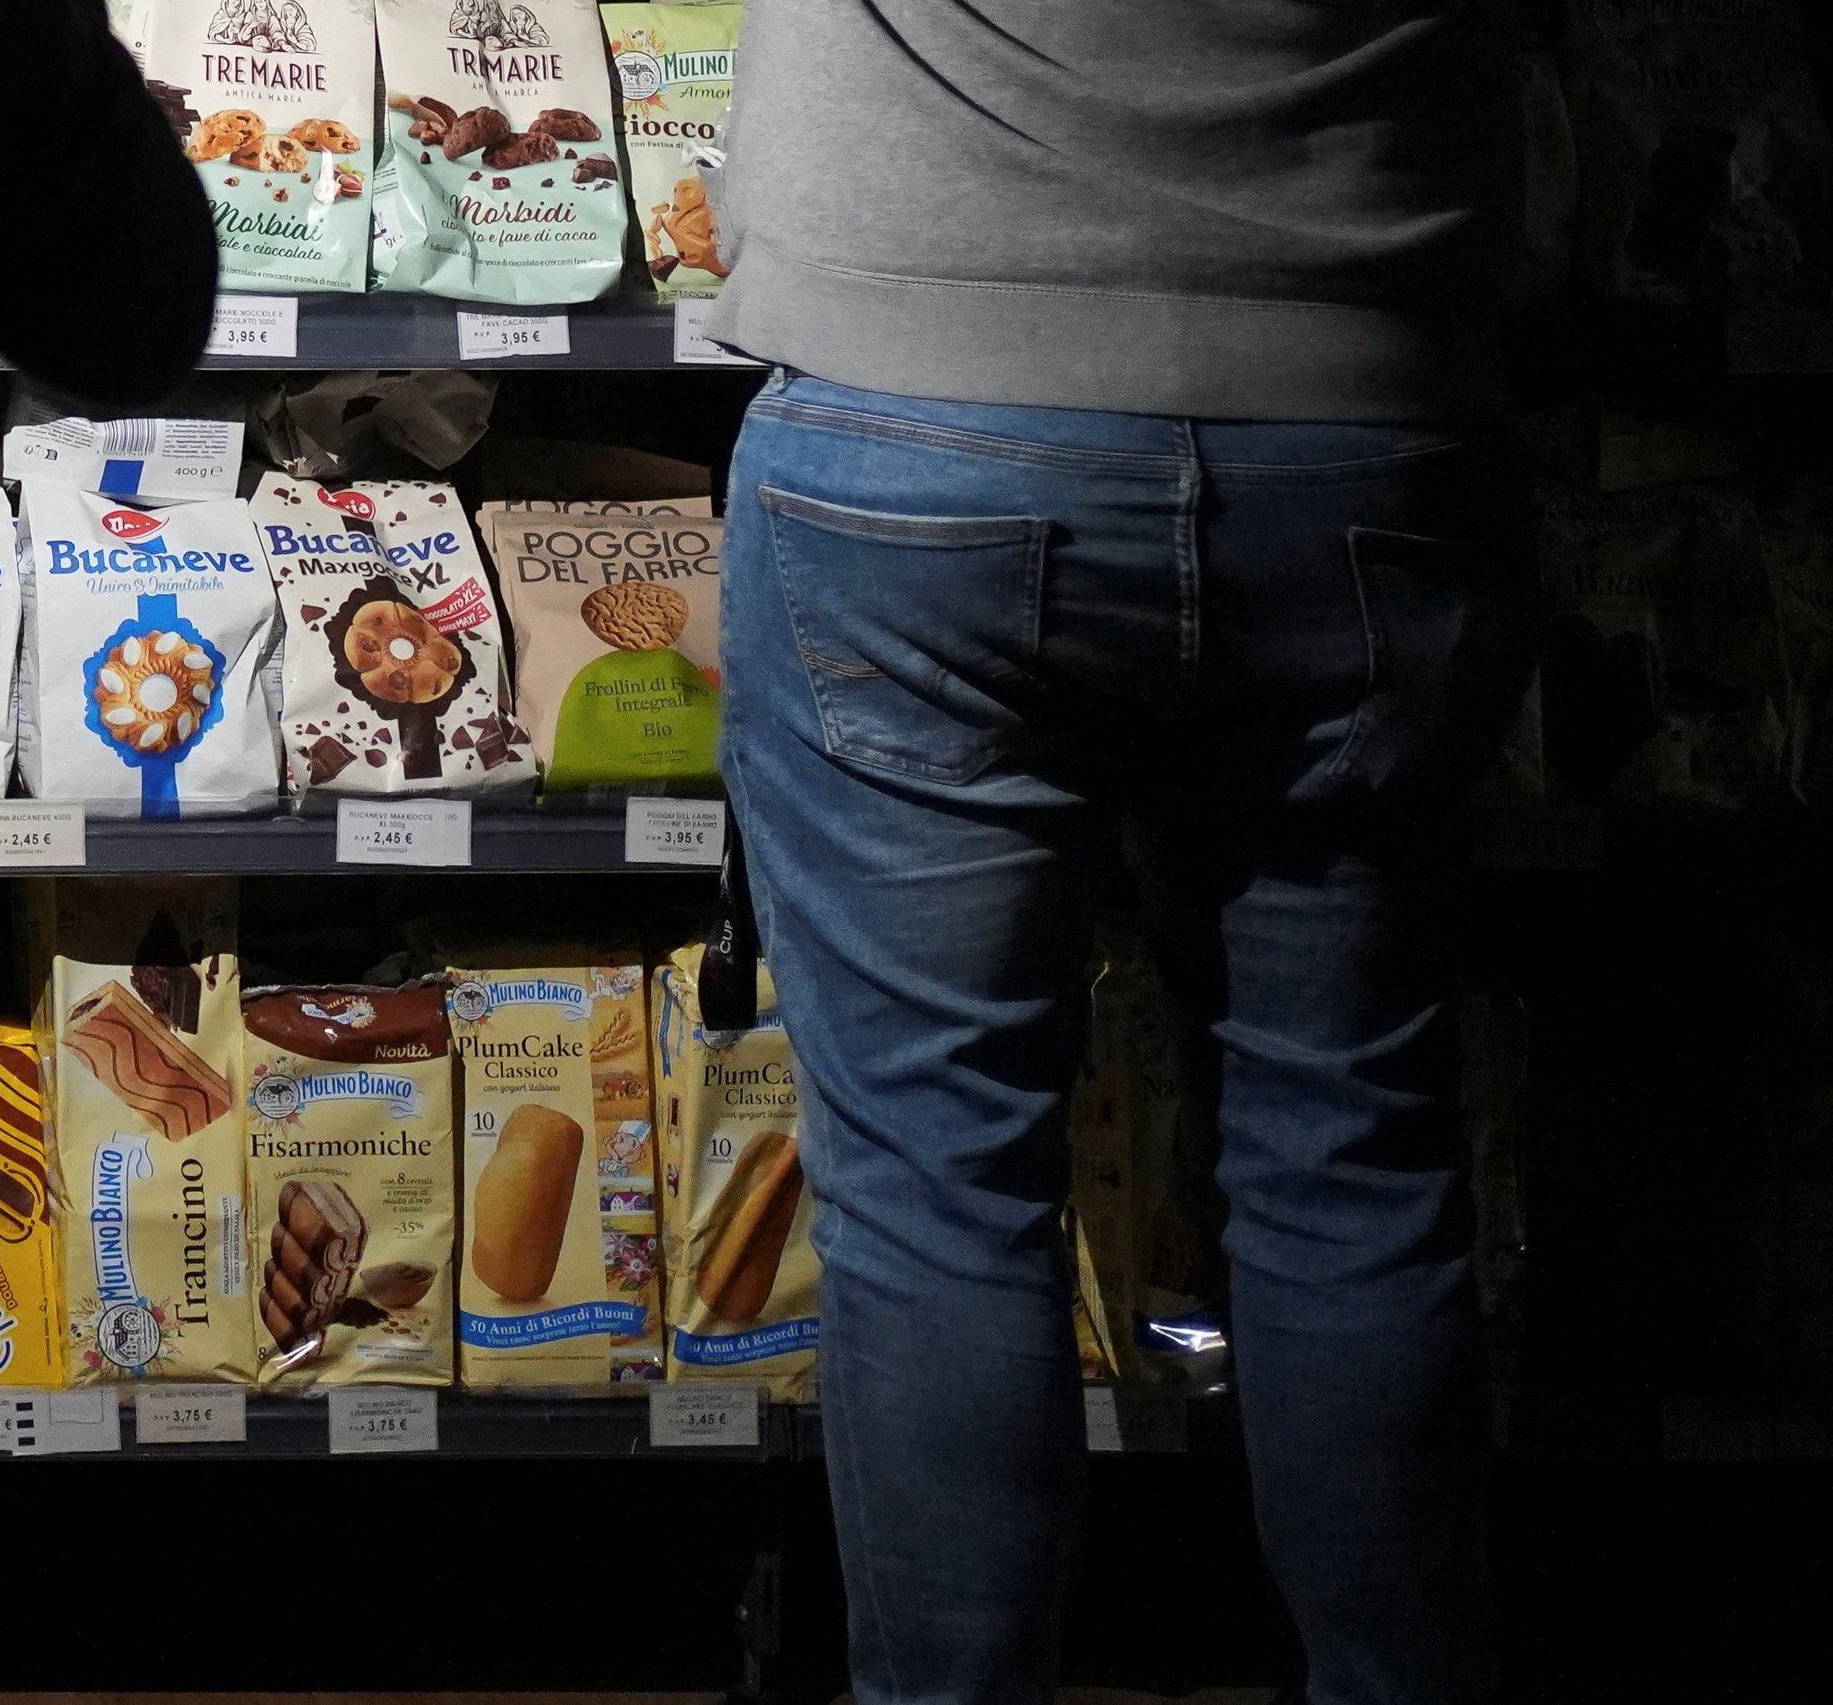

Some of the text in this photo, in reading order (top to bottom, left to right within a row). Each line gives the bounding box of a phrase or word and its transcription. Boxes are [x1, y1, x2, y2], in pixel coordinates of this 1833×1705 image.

[202, 53, 328, 93] TREMARIE
[448, 193, 578, 227] Morbidi
[498, 229, 600, 247] fave di cacao
[253, 241, 324, 262] cioccolato
[228, 331, 256, 342] 3,95
[264, 524, 460, 568] Bucaneve
[524, 530, 711, 560] POGGIO
[46, 539, 255, 575] Bucaneve
[413, 562, 451, 594] XL
[517, 557, 590, 585] DEL
[87, 574, 225, 595] Unico Inimitabile
[584, 678, 645, 697] Frollini
[614, 694, 693, 714] Integrale
[643, 721, 673, 738] Bio
[11, 834, 39, 847] 2,45
[373, 832, 401, 845] 2,45
[719, 918, 735, 956] CUP
[375, 1043, 432, 1060] Novità
[458, 1034, 584, 1060] PlumCake
[484, 1061, 559, 1079] Classico
[724, 1086, 798, 1106] Classico
[472, 1110, 495, 1131] 10
[250, 1131, 433, 1158] Fisarmoniche
[710, 1138, 733, 1158] 10
[92, 1148, 123, 1224] BIANCO
[174, 1157, 209, 1339] Trancino
[469, 1305, 634, 1336] 50 Anni di Ricordi Buoni
[173, 1409, 201, 1422] 3,75
[368, 1420, 395, 1432] 3,75
